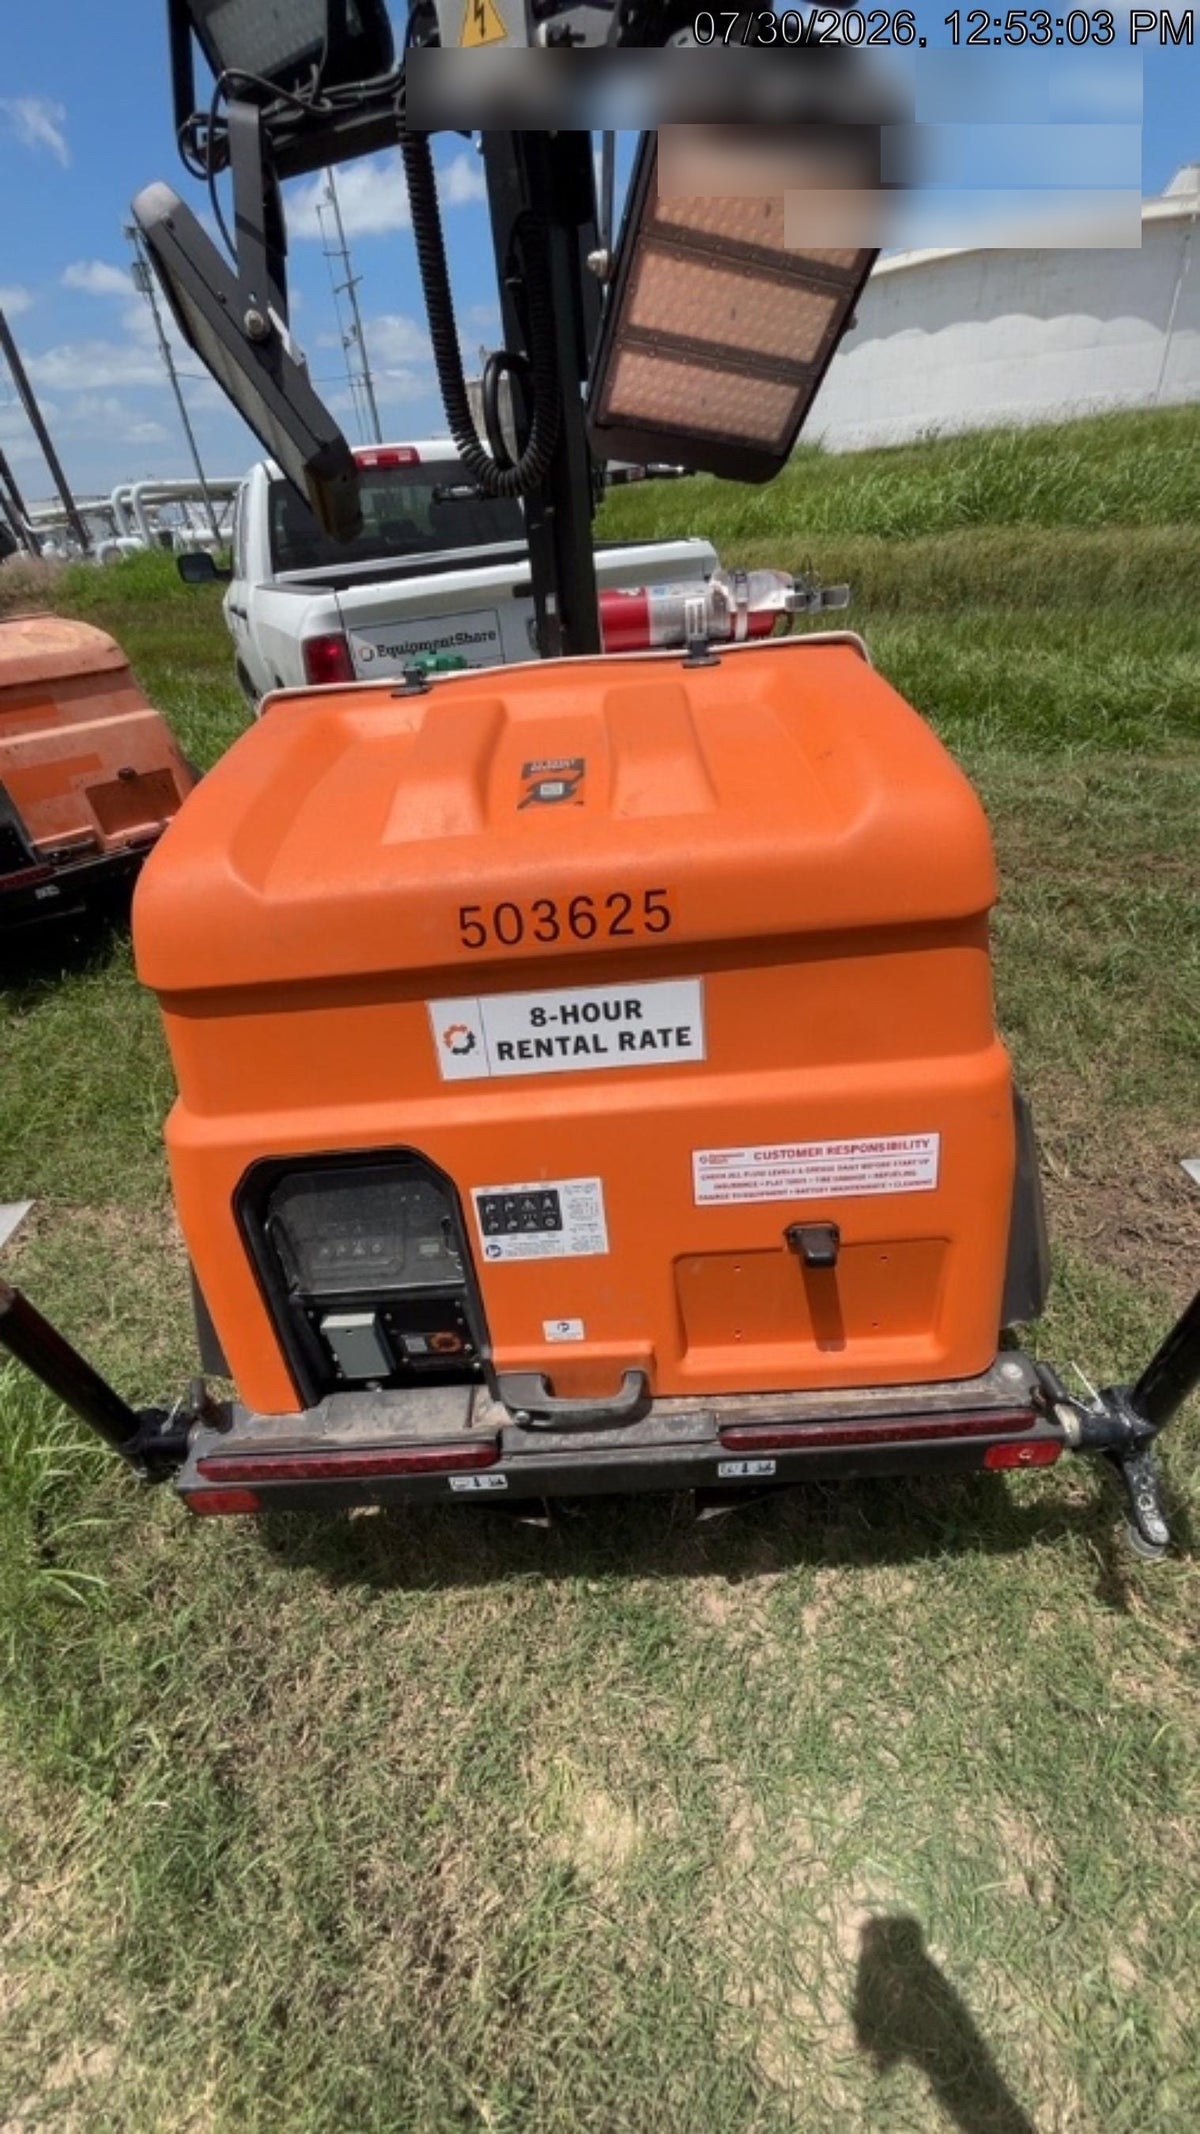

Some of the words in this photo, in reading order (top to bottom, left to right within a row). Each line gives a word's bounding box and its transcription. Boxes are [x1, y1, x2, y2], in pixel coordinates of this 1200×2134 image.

[376, 629, 497, 658] EquipmentShare
[458, 889, 671, 948] 503625
[530, 1000, 643, 1027] 8-HOUR
[497, 1033, 608, 1060] RENTAL
[618, 1026, 692, 1050] RATE
[753, 1147, 823, 1160] CUSTOMER
[827, 1138, 930, 1155] RESPONSIBILITY
